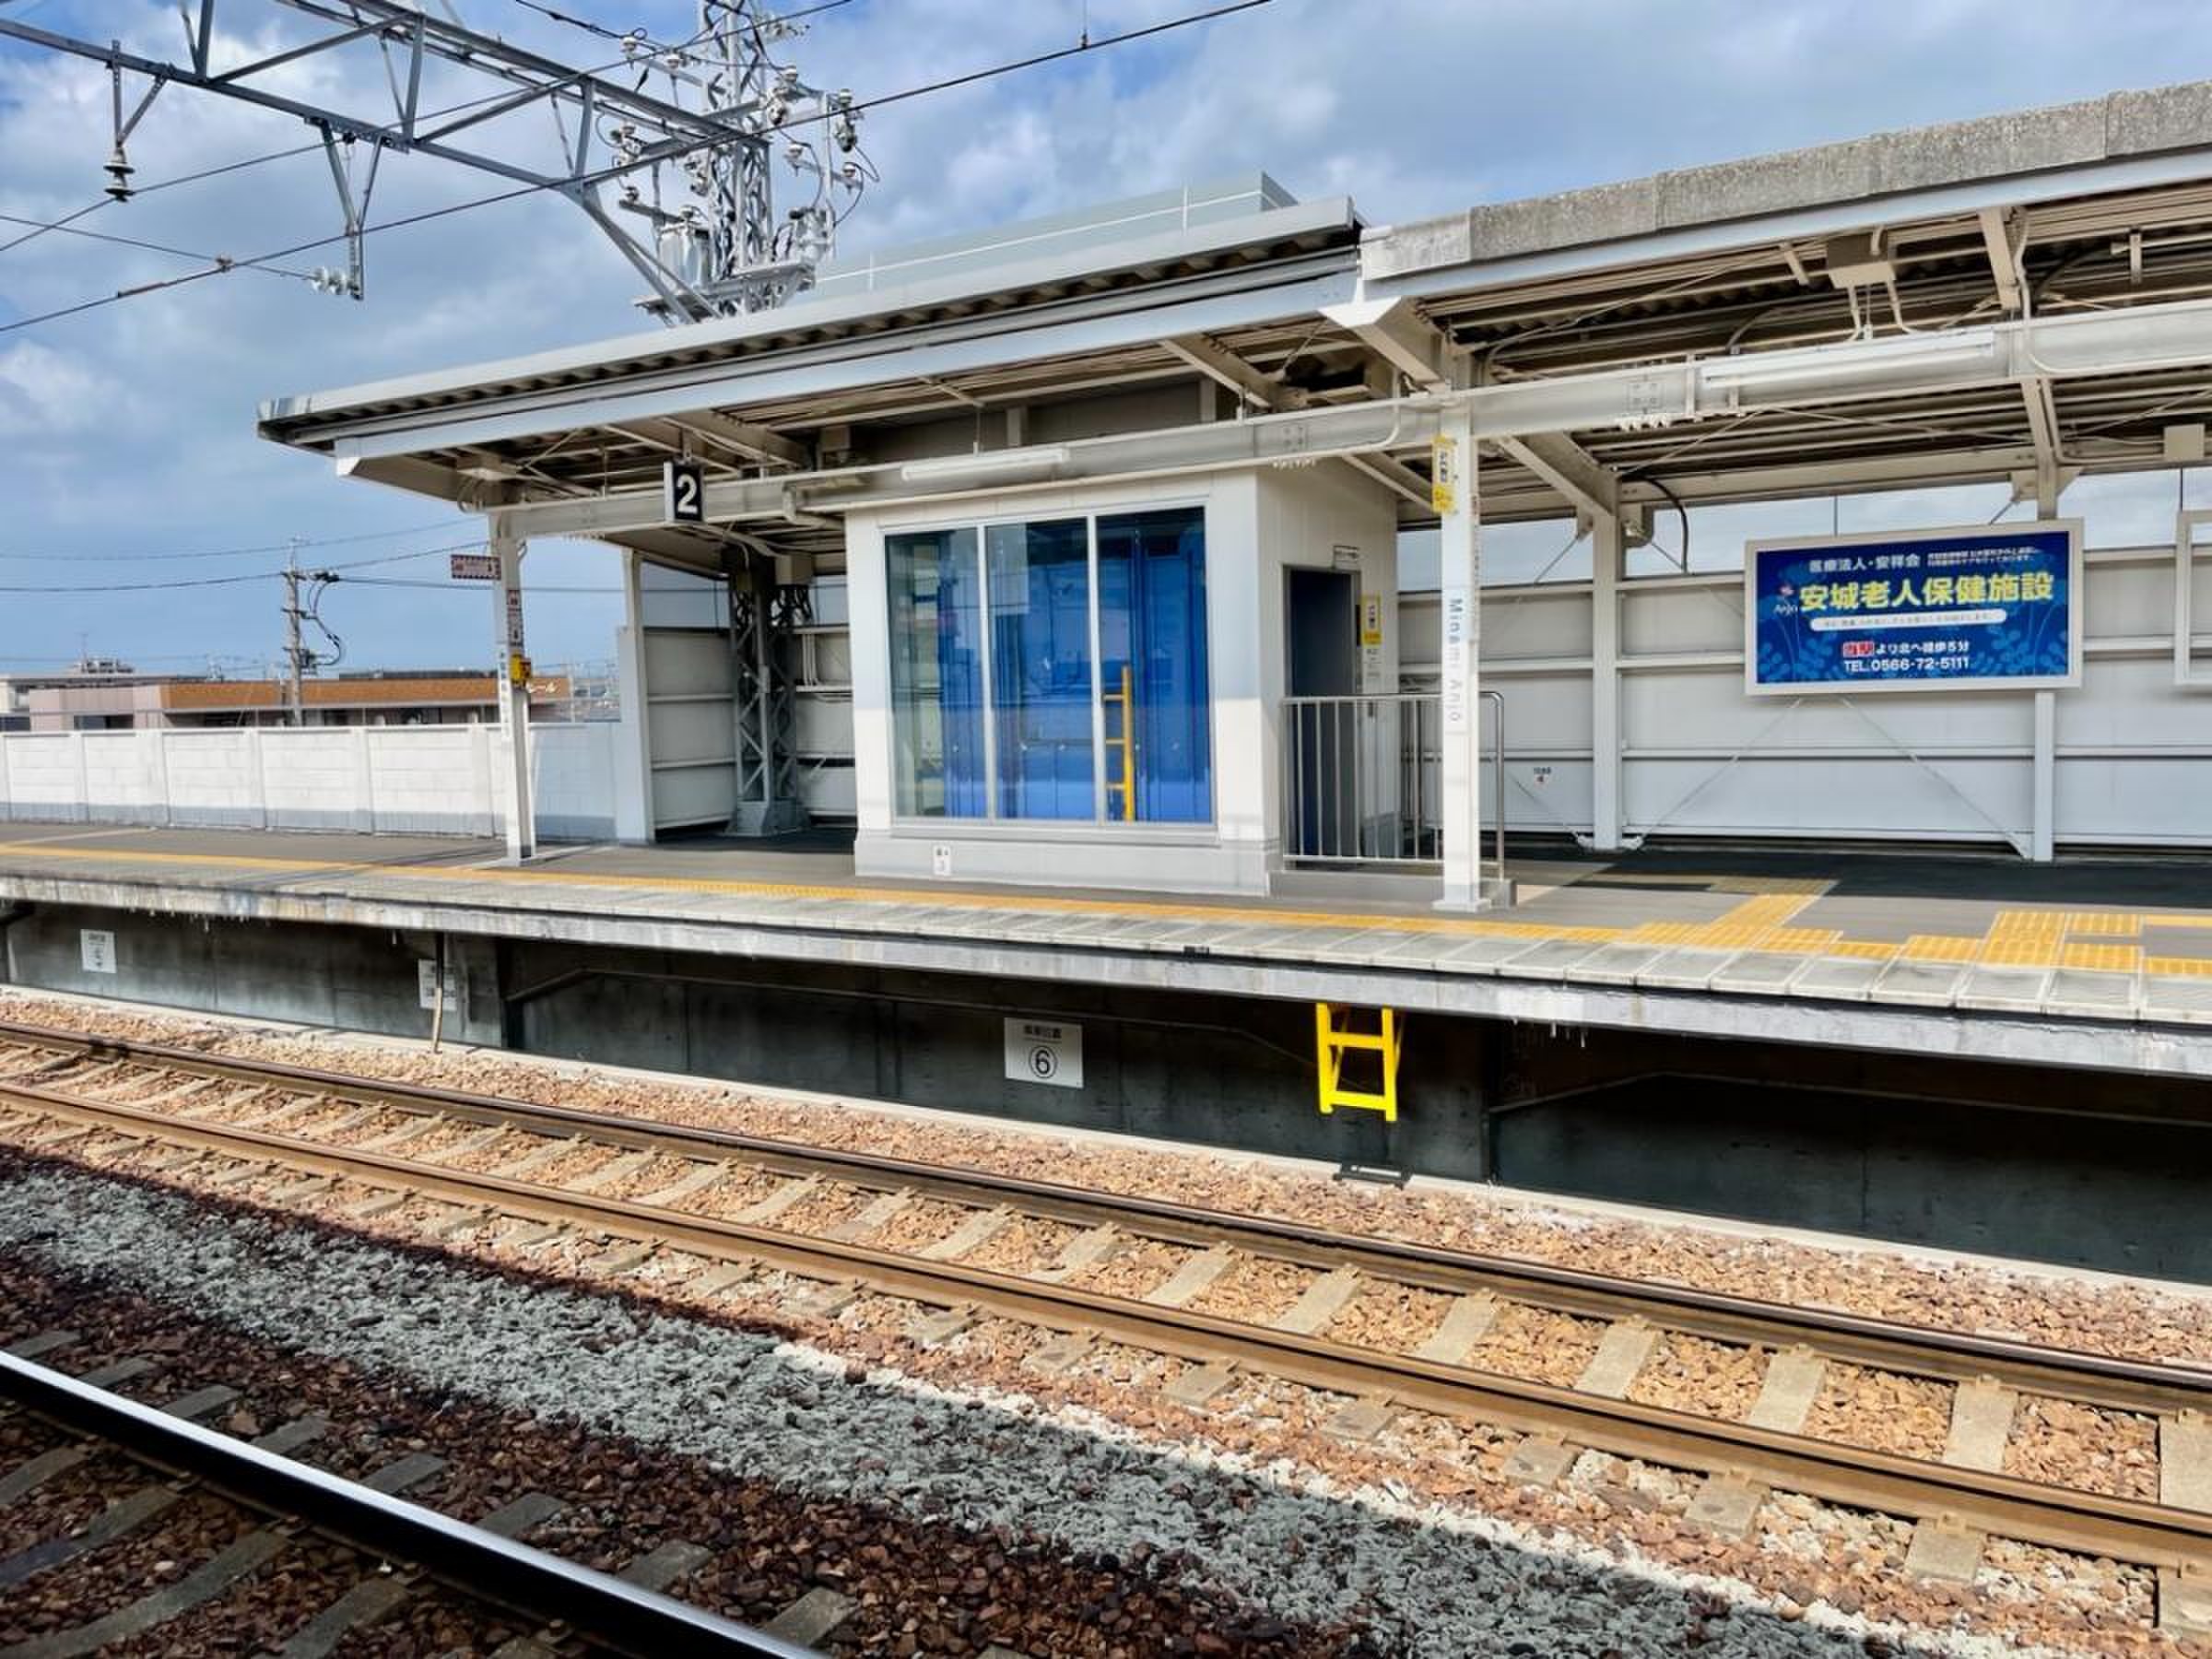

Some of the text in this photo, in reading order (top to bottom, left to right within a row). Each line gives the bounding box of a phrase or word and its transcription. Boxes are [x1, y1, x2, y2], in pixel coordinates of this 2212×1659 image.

[676, 474, 698, 514] 2
[1800, 571, 2053, 611] 安城老人保健施設
